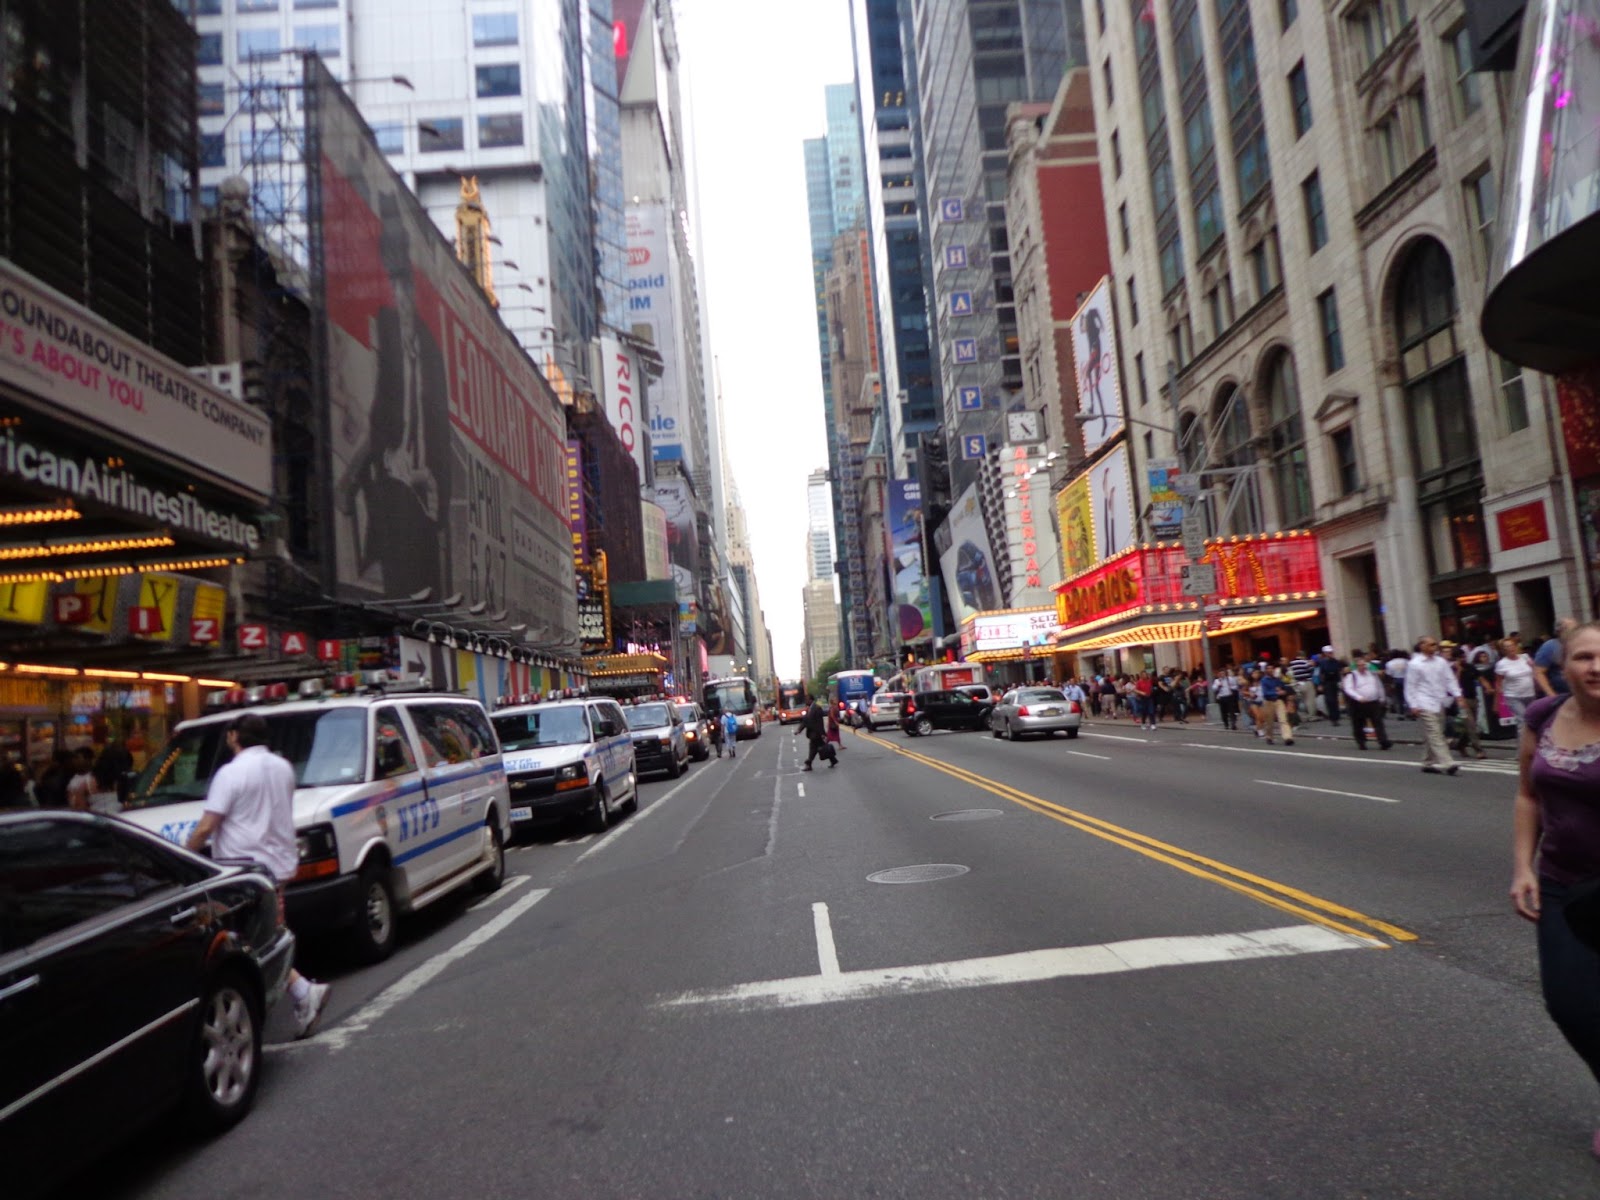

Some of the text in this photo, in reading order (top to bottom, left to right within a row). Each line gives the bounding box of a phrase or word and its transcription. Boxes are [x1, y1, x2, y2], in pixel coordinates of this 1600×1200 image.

[0, 288, 131, 377] OUNDABOUT
[136, 360, 198, 410] THEATRE
[201, 398, 265, 446] COMPANY
[32, 338, 102, 391] ABOUT
[944, 200, 981, 456] CHAMPS
[615, 352, 635, 453] RICO
[0, 428, 259, 549] icanAirlinesTheatre
[1013, 446, 1041, 588] AMSTERDAM
[397, 797, 440, 843] NYPD
